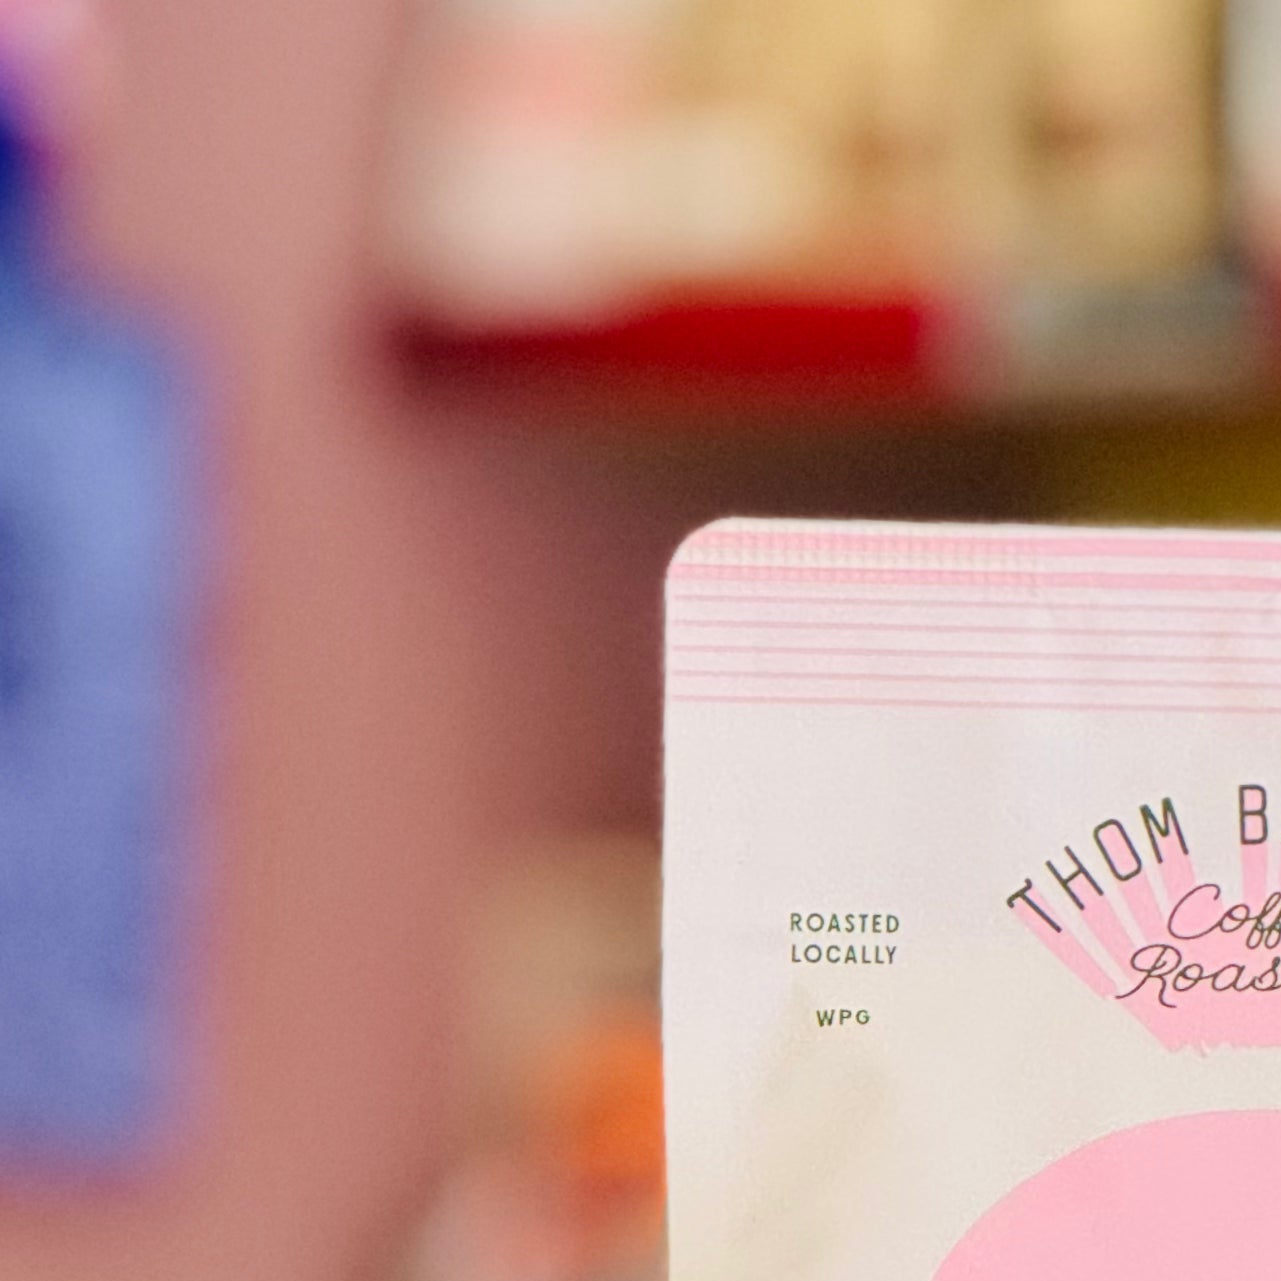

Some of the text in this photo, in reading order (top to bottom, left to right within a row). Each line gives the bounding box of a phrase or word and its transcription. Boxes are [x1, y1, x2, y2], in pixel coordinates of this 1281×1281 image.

[1006, 796, 1190, 935] THOM
[789, 912, 901, 935] ROASTED
[790, 943, 899, 966] LOCALLY
[816, 1007, 872, 1028] WPG
